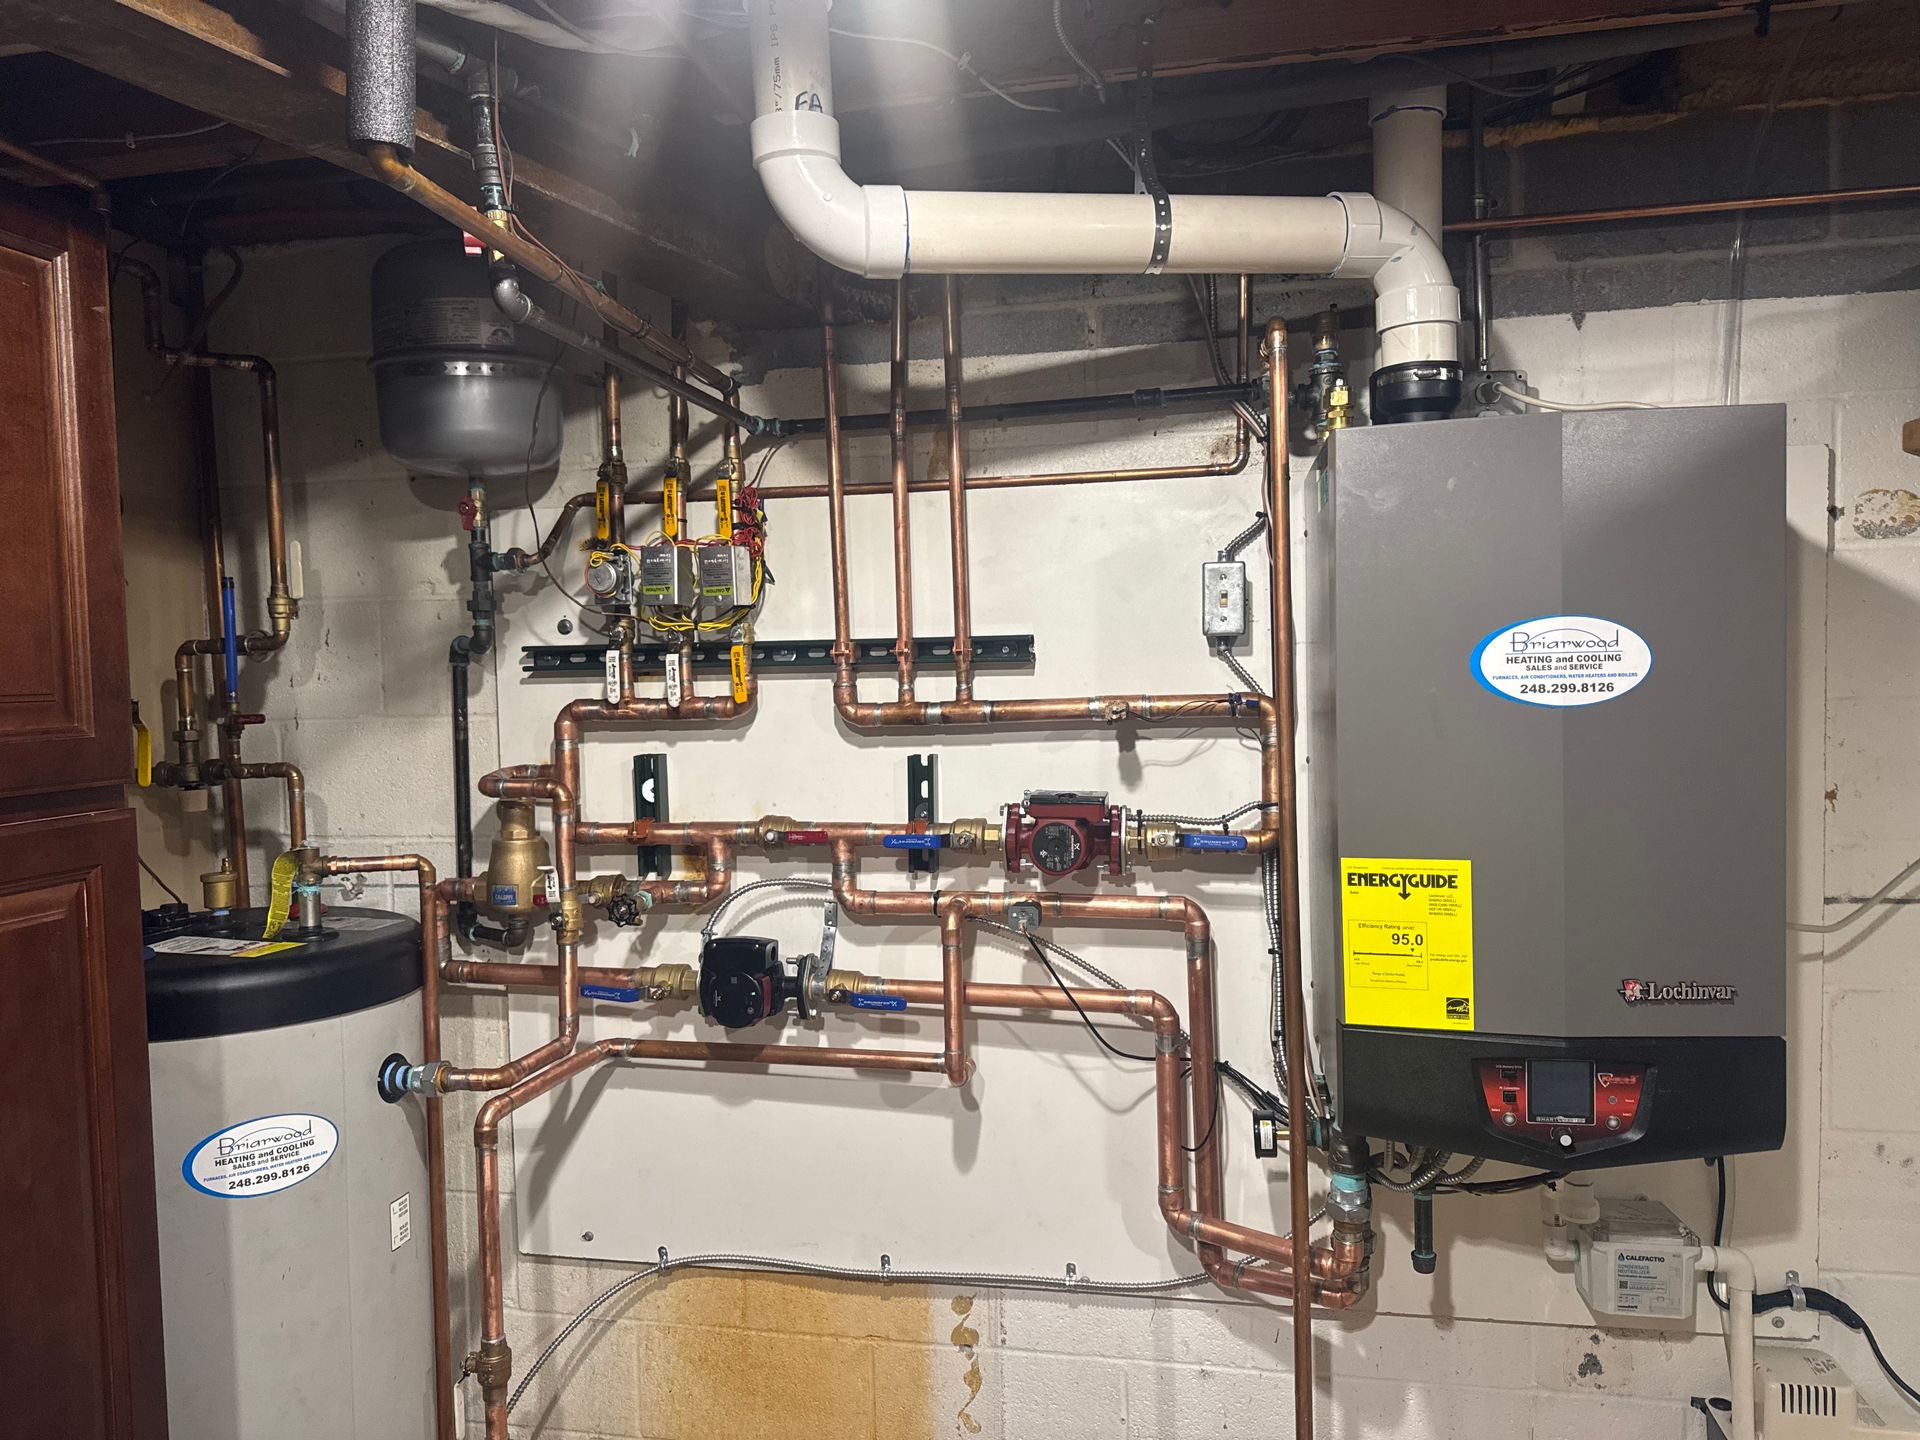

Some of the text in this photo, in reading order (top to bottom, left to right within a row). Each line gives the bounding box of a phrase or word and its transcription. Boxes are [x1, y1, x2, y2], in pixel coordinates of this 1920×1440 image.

[795, 90, 824, 114] FA
[1509, 629, 1620, 652] Briarwood
[1506, 654, 1622, 664] HEATING and COOLING
[1520, 682, 1615, 694] 248.299.8126
[1347, 872, 1458, 889] ENERGYGUIDE
[1391, 933, 1424, 946] 95.0
[1648, 982, 1736, 1000] Lochinvar
[217, 1119, 312, 1156] Briarwood
[214, 1139, 315, 1167] HEATING and COOLING
[232, 1161, 256, 1170] SALES
[270, 1151, 300, 1162] SERVICE
[228, 1163, 310, 1190] 248.299.8126
